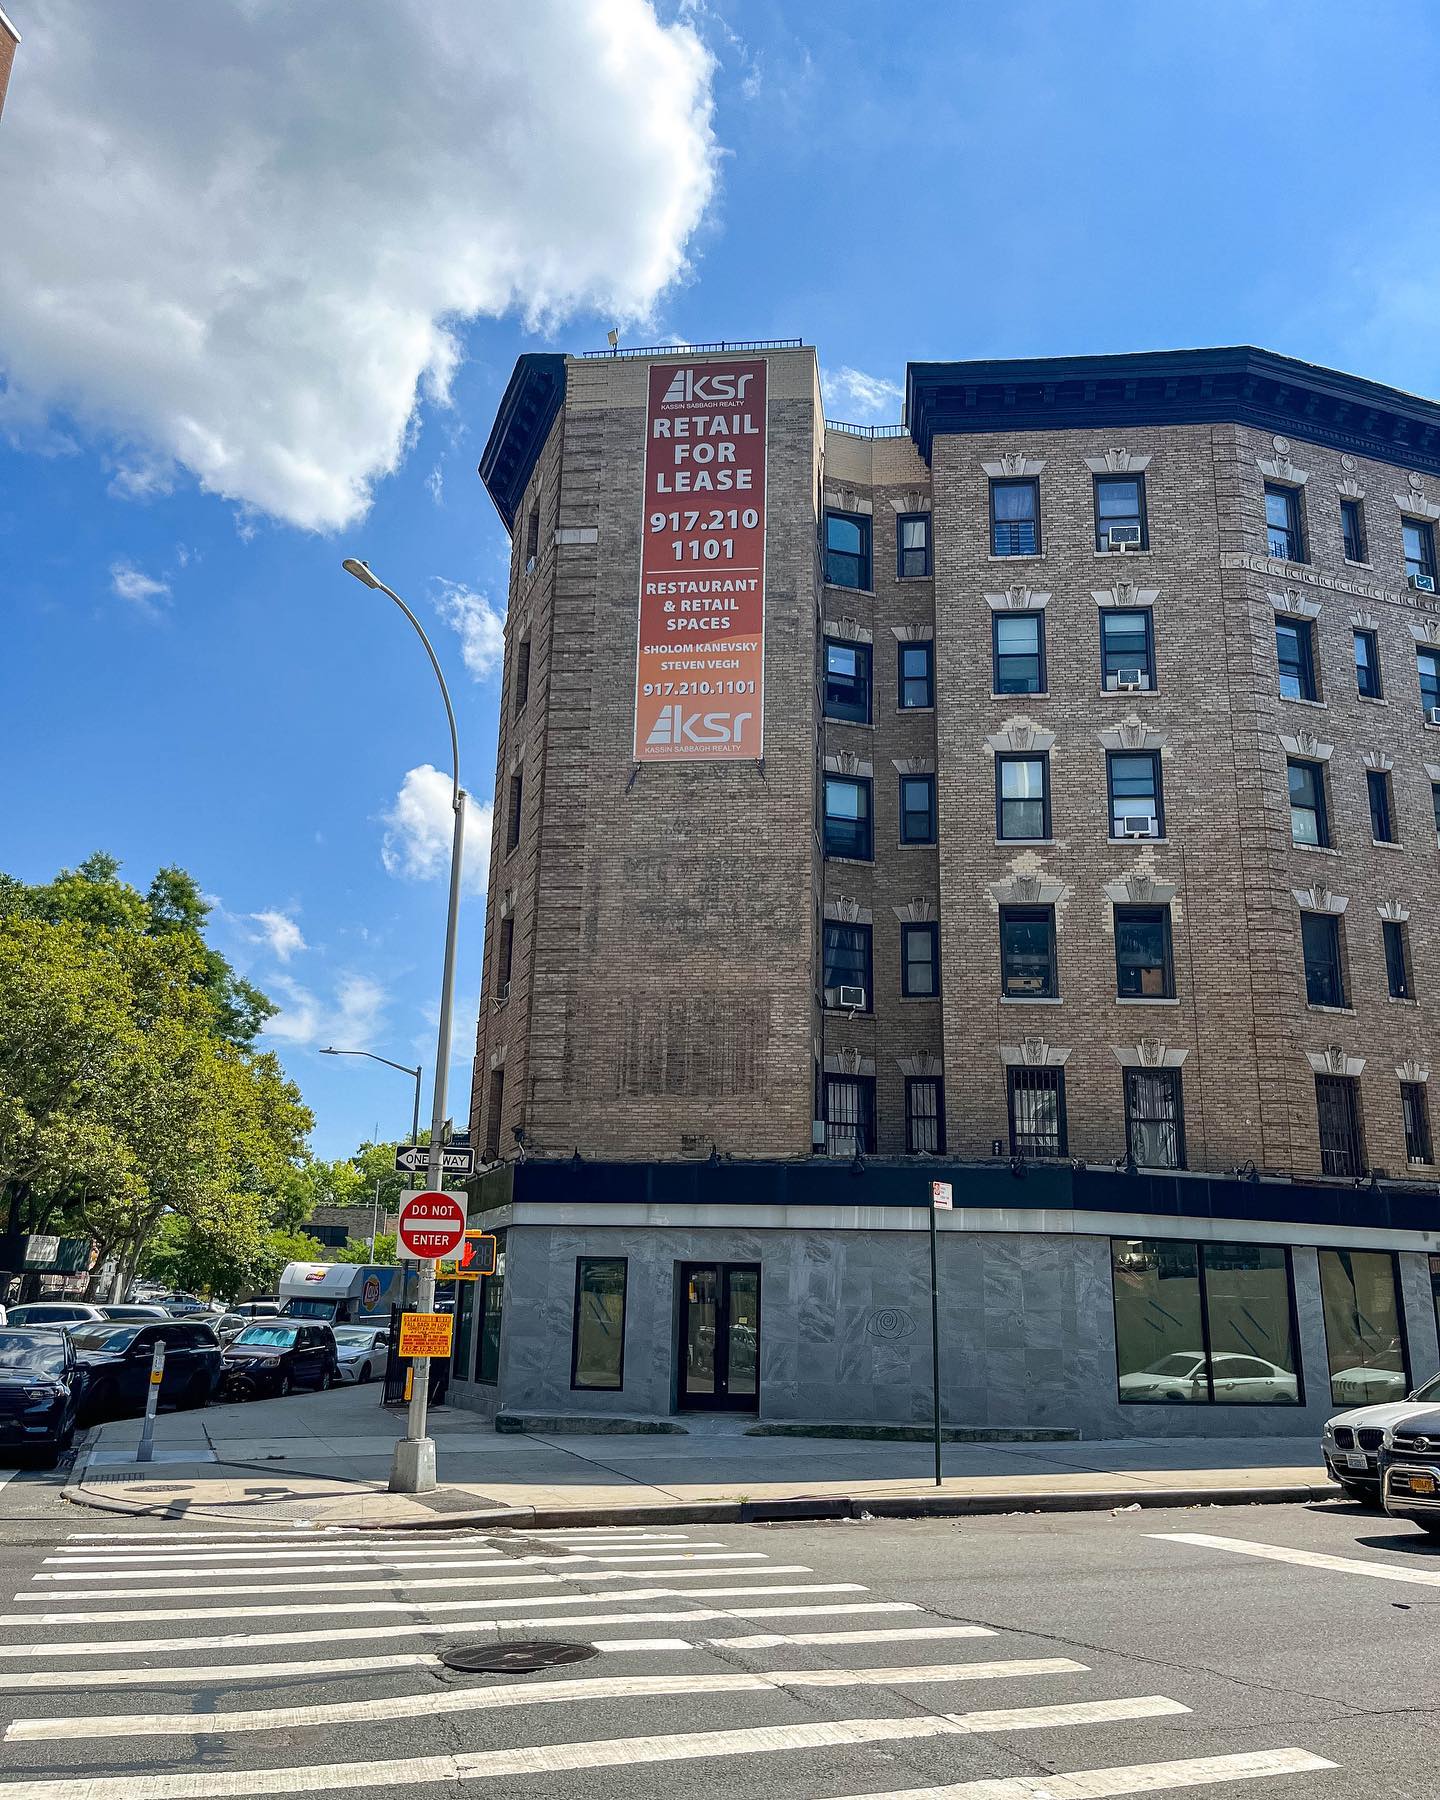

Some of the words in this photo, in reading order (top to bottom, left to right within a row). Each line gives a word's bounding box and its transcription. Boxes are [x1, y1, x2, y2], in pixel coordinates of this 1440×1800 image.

[653, 414, 759, 438] RETAIL
[674, 442, 736, 464] FOR
[656, 469, 753, 493] LEASE
[650, 508, 759, 533] 917.210
[672, 539, 734, 560] 1101
[646, 579, 758, 595] RESTAURANT
[663, 600, 676, 612] &
[681, 598, 739, 612] RETAIL
[667, 617, 731, 631] SPACES
[643, 644, 693, 654] SHOLOM
[695, 642, 758, 653] KANEVSKY
[661, 660, 705, 671] STEVEN
[707, 659, 740, 669] VEGH
[643, 680, 756, 696] 917.210.1101
[712, 744, 742, 752] REALTY
[406, 1154, 429, 1164] ONE
[443, 1156, 466, 1166] WAY
[412, 1204, 428, 1215] DO
[432, 1205, 454, 1216] NOT
[412, 1234, 449, 1246] ENTER
